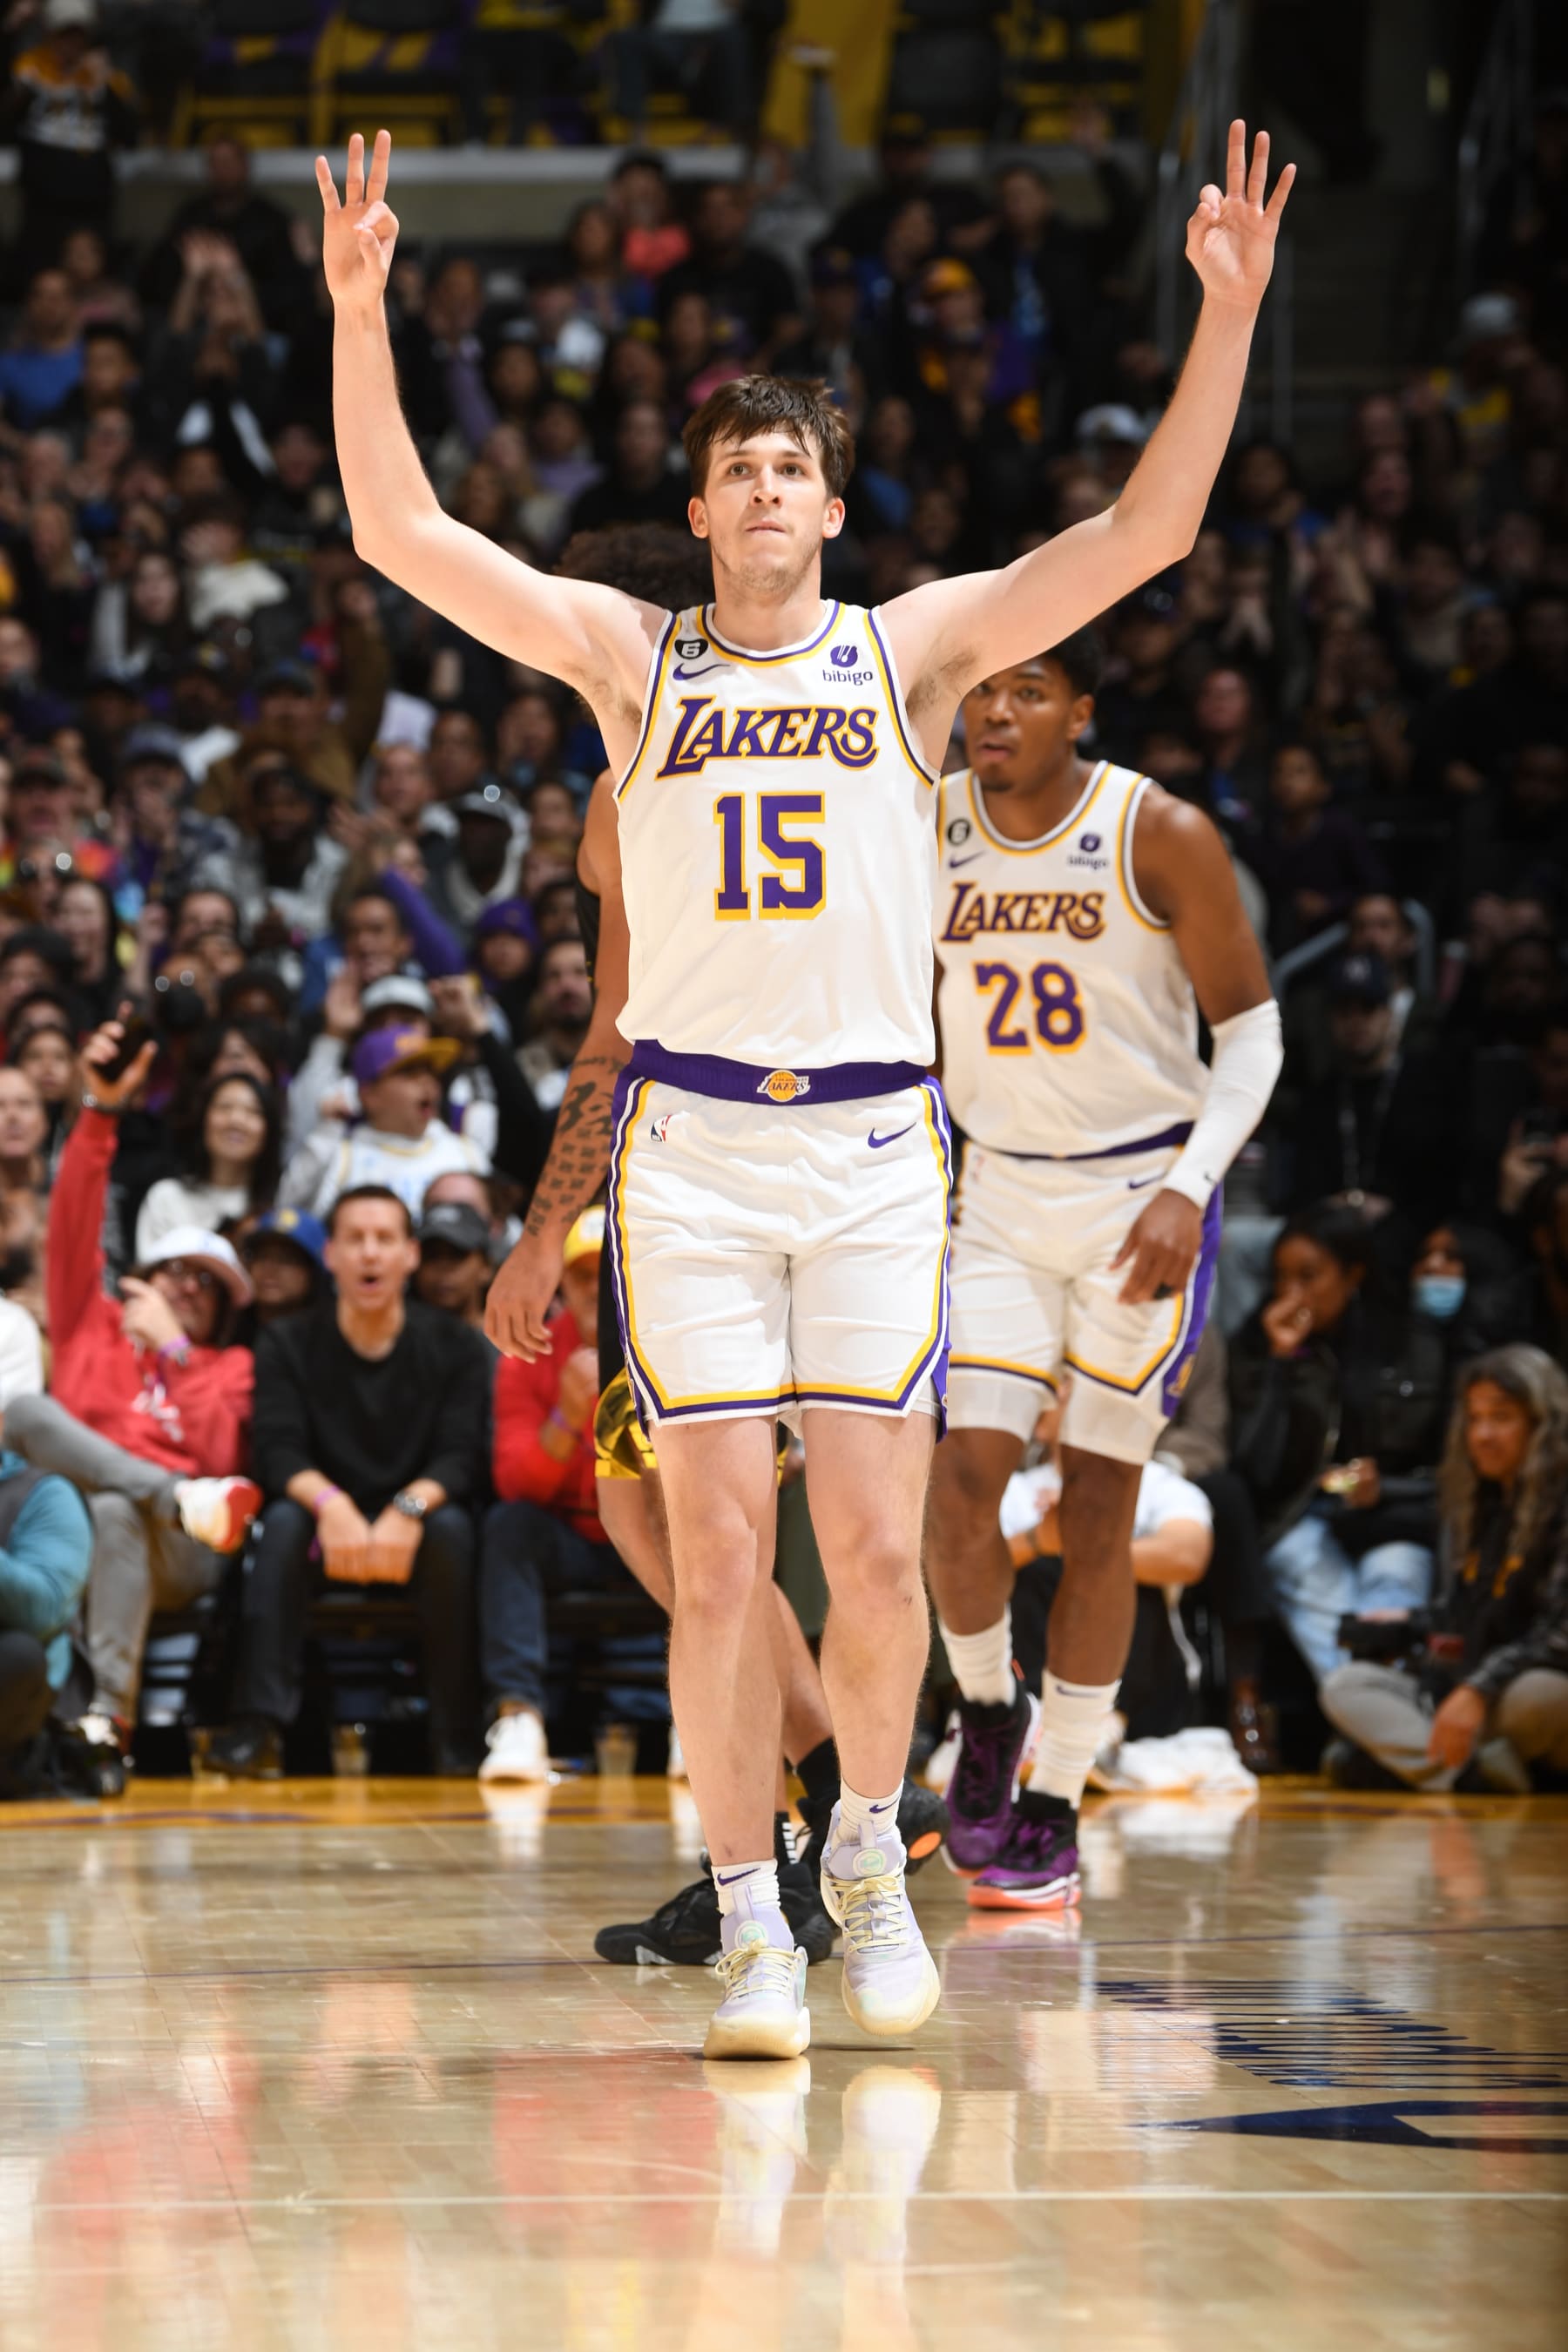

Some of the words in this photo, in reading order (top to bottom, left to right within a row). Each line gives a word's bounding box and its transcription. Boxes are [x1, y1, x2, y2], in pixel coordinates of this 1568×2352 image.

[681, 641, 700, 657] 6
[822, 669, 874, 686] bibigo
[654, 695, 879, 781] LAKERS
[713, 791, 826, 921] 15
[940, 881, 1106, 943] LAKERS
[972, 960, 1087, 1056] 28
